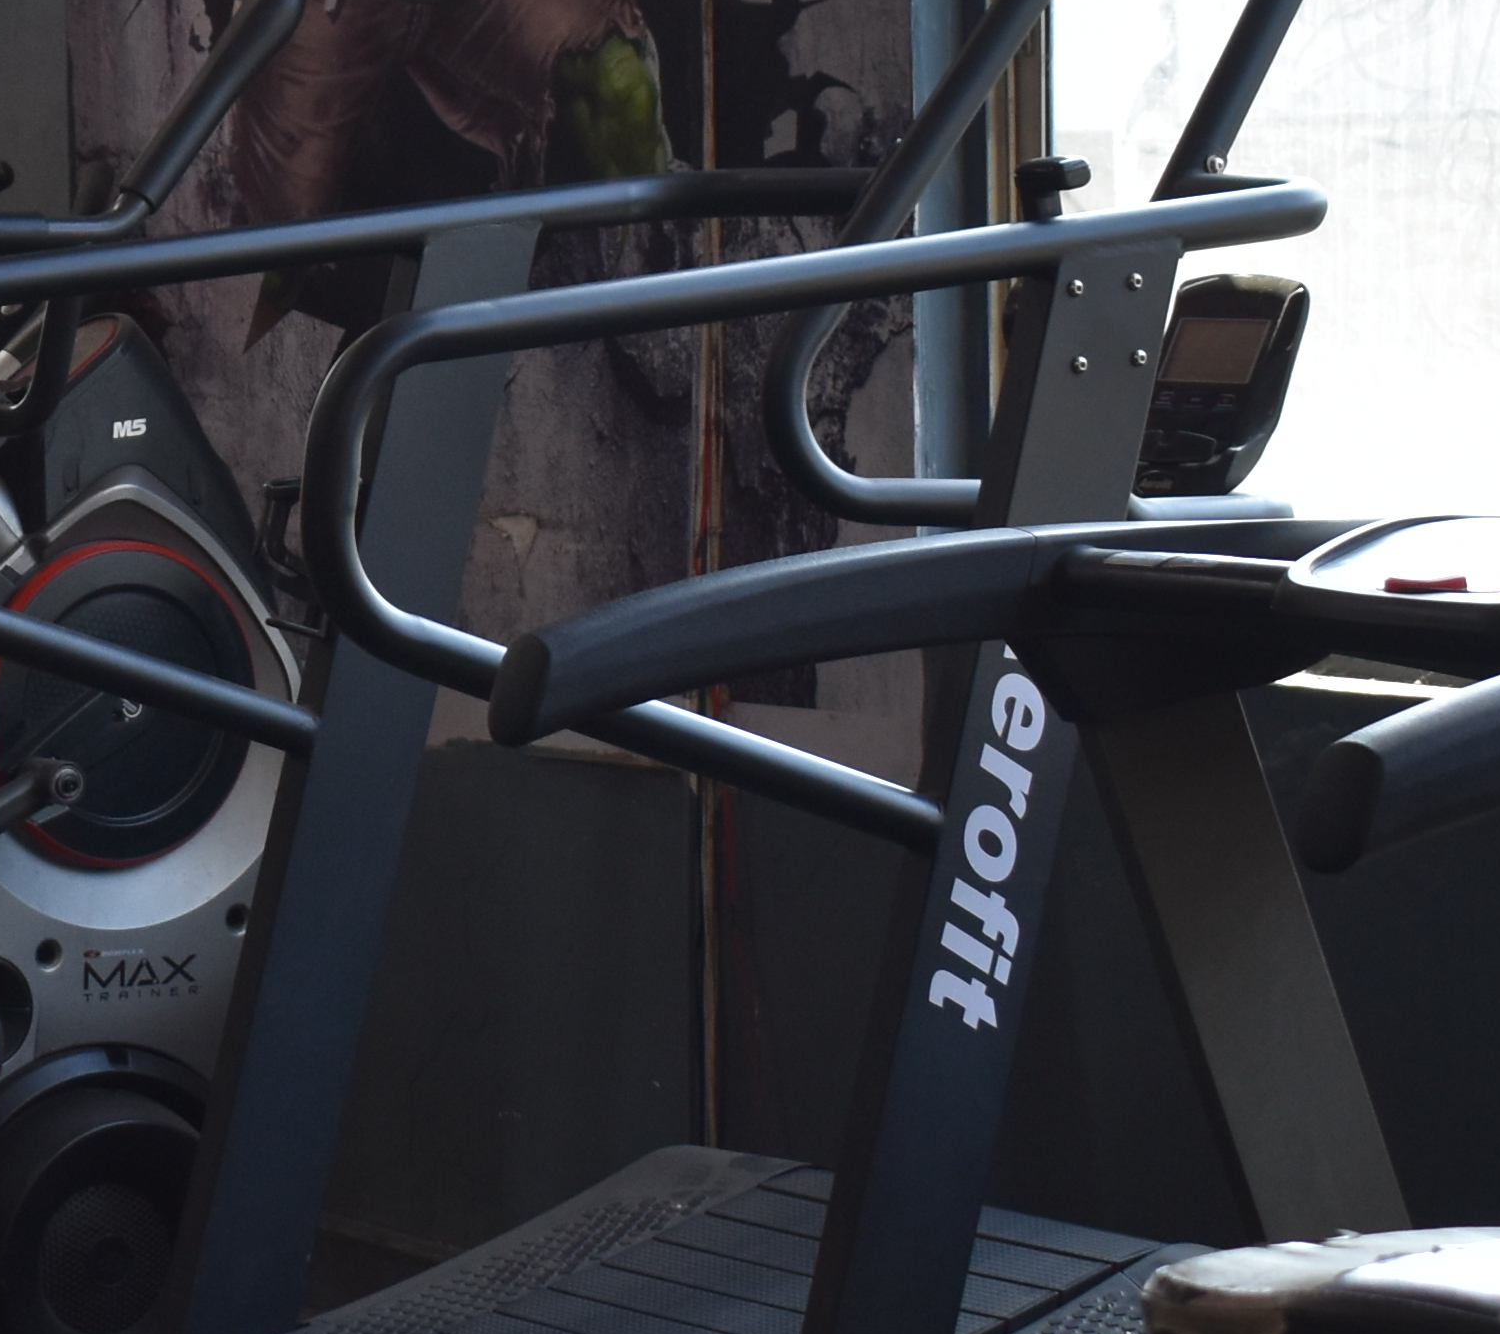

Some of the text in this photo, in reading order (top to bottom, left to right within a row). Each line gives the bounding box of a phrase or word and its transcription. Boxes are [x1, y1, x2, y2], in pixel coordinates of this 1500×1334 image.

[112, 417, 147, 440] M5
[929, 643, 1046, 1031] erofit
[83, 954, 198, 991] MAX
[83, 985, 199, 1002] TRAINER
